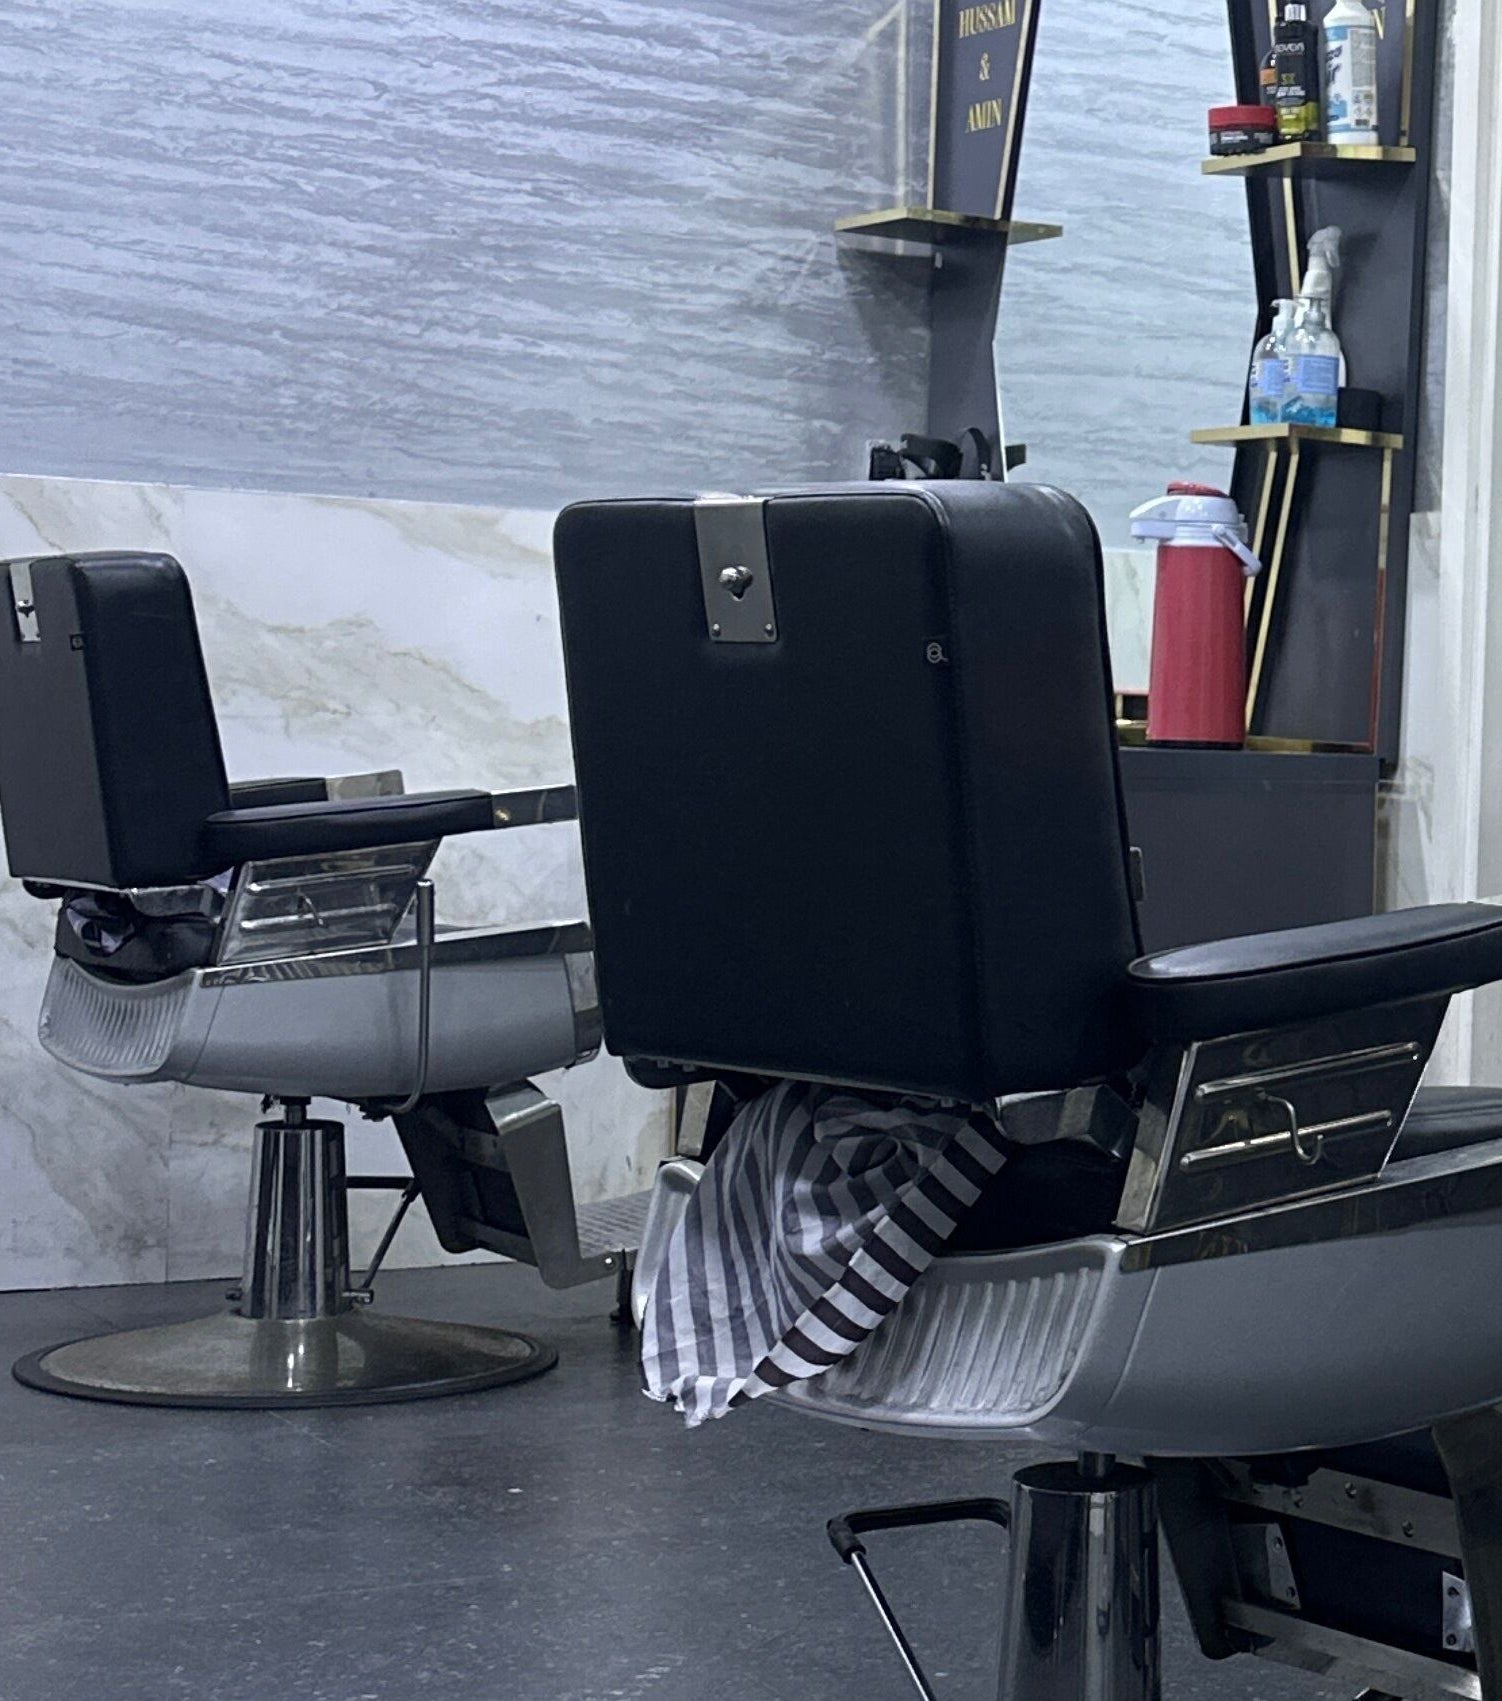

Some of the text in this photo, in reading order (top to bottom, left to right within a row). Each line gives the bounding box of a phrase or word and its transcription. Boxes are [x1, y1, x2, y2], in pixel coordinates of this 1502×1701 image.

[959, 0, 1016, 39] HUSSAM
[979, 52, 990, 80] &
[964, 98, 1002, 134] AMIN
